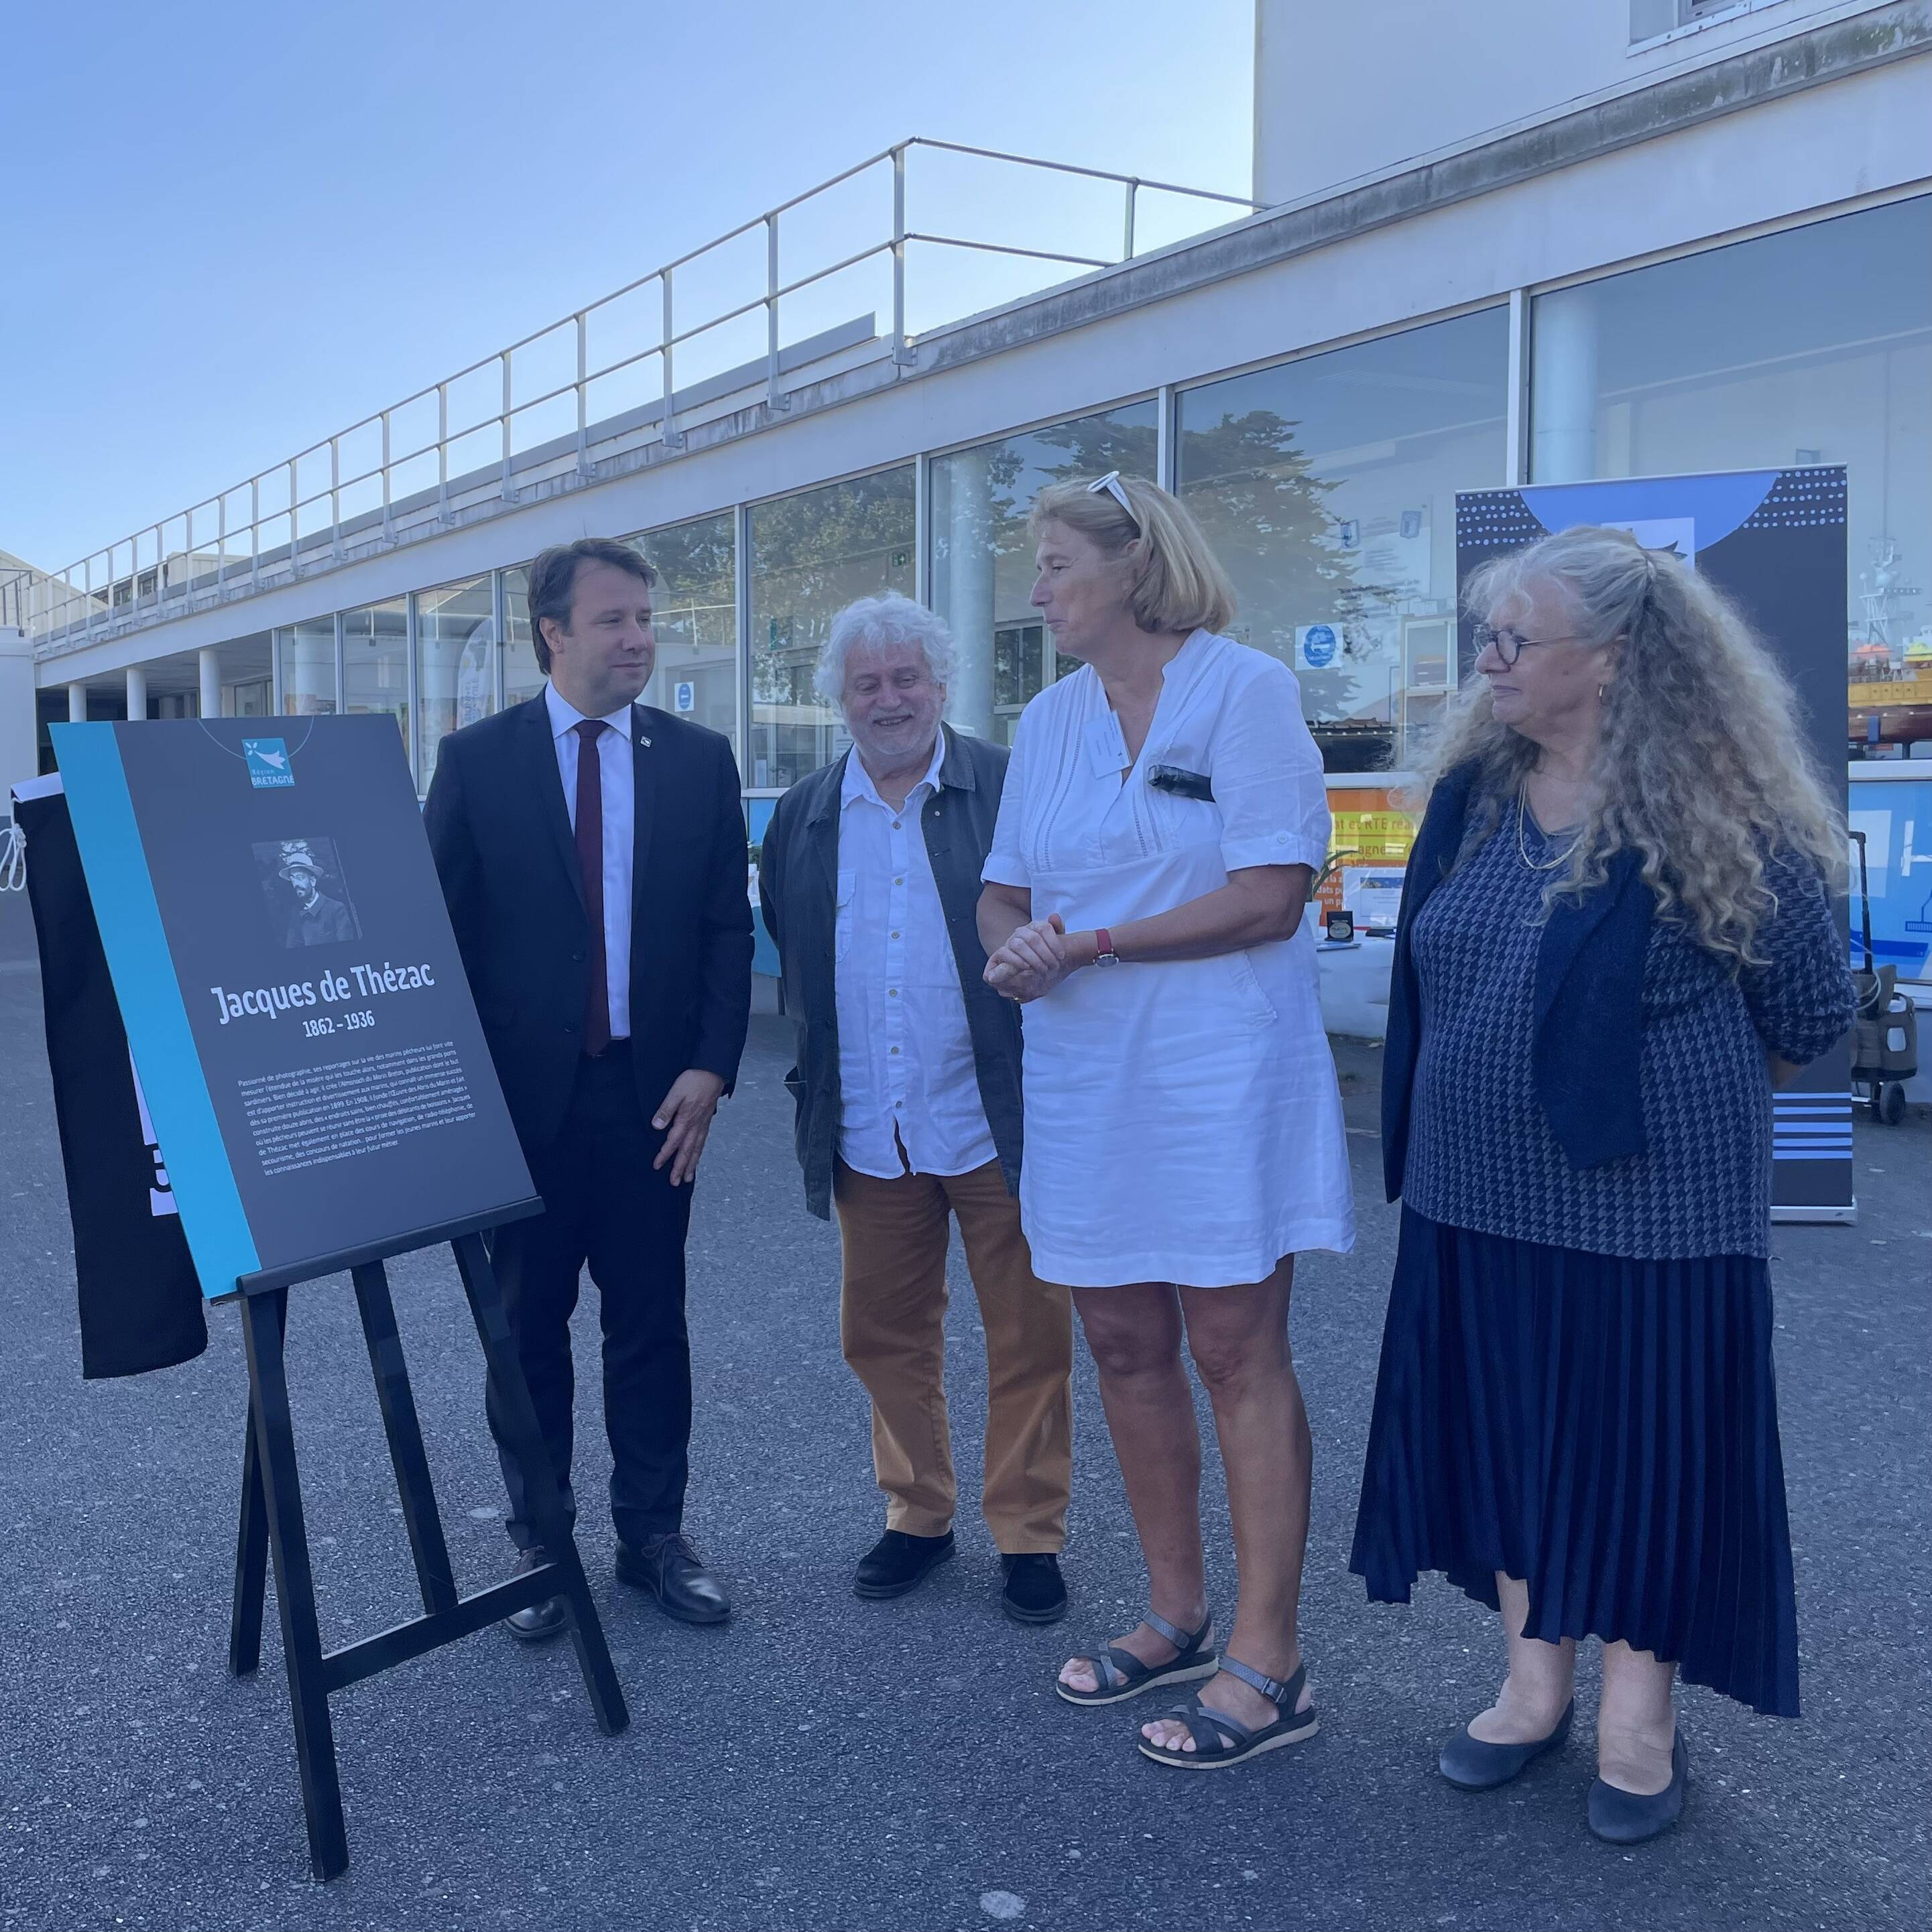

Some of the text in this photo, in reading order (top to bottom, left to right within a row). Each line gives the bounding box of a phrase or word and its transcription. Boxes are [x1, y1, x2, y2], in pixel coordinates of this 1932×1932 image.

[251, 775, 295, 786] BRETAGNE
[210, 962, 435, 1025] Jacques de Thézac
